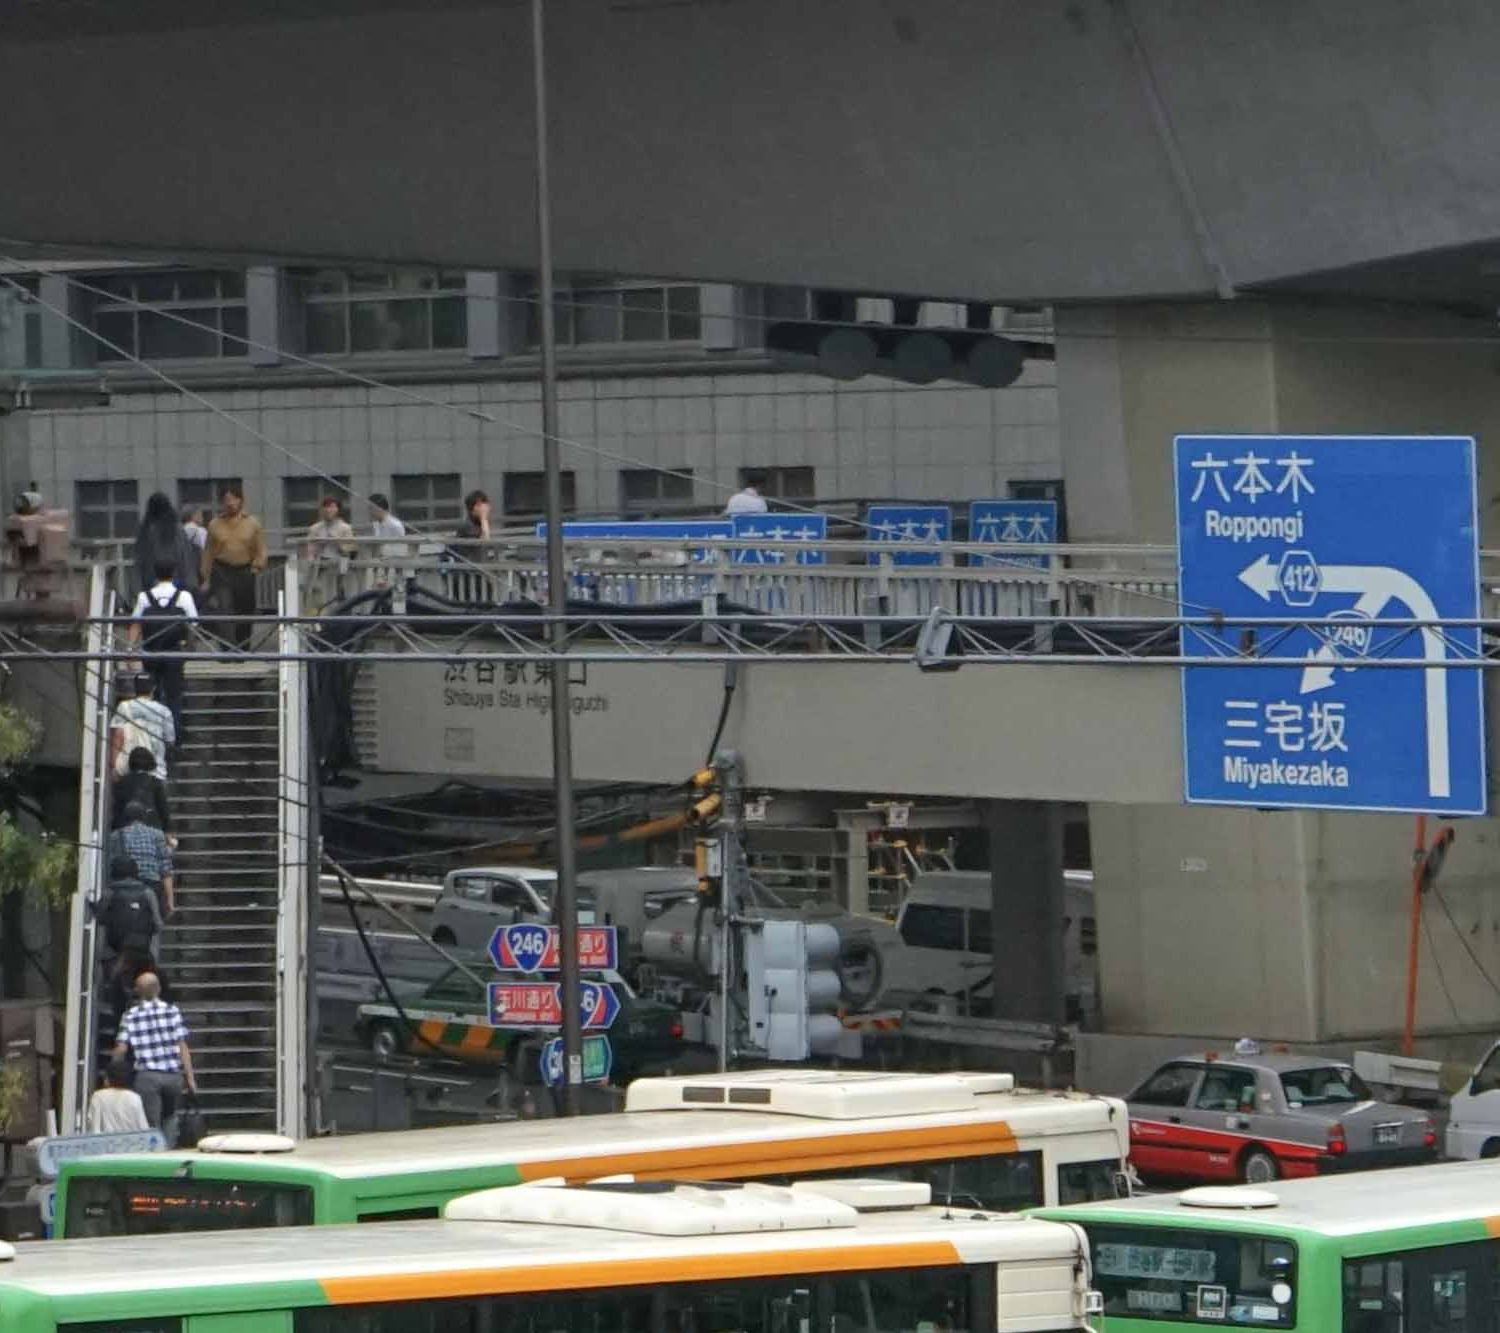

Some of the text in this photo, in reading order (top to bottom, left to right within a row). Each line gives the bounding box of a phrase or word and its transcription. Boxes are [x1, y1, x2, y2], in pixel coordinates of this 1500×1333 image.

[1190, 452, 1315, 503] 六本木
[1205, 510, 1304, 543] Roppongi
[1284, 565, 1316, 592] 412
[1223, 701, 1349, 752] 三宅坂
[1223, 757, 1349, 790] Miyakezaka
[512, 931, 544, 955] 246
